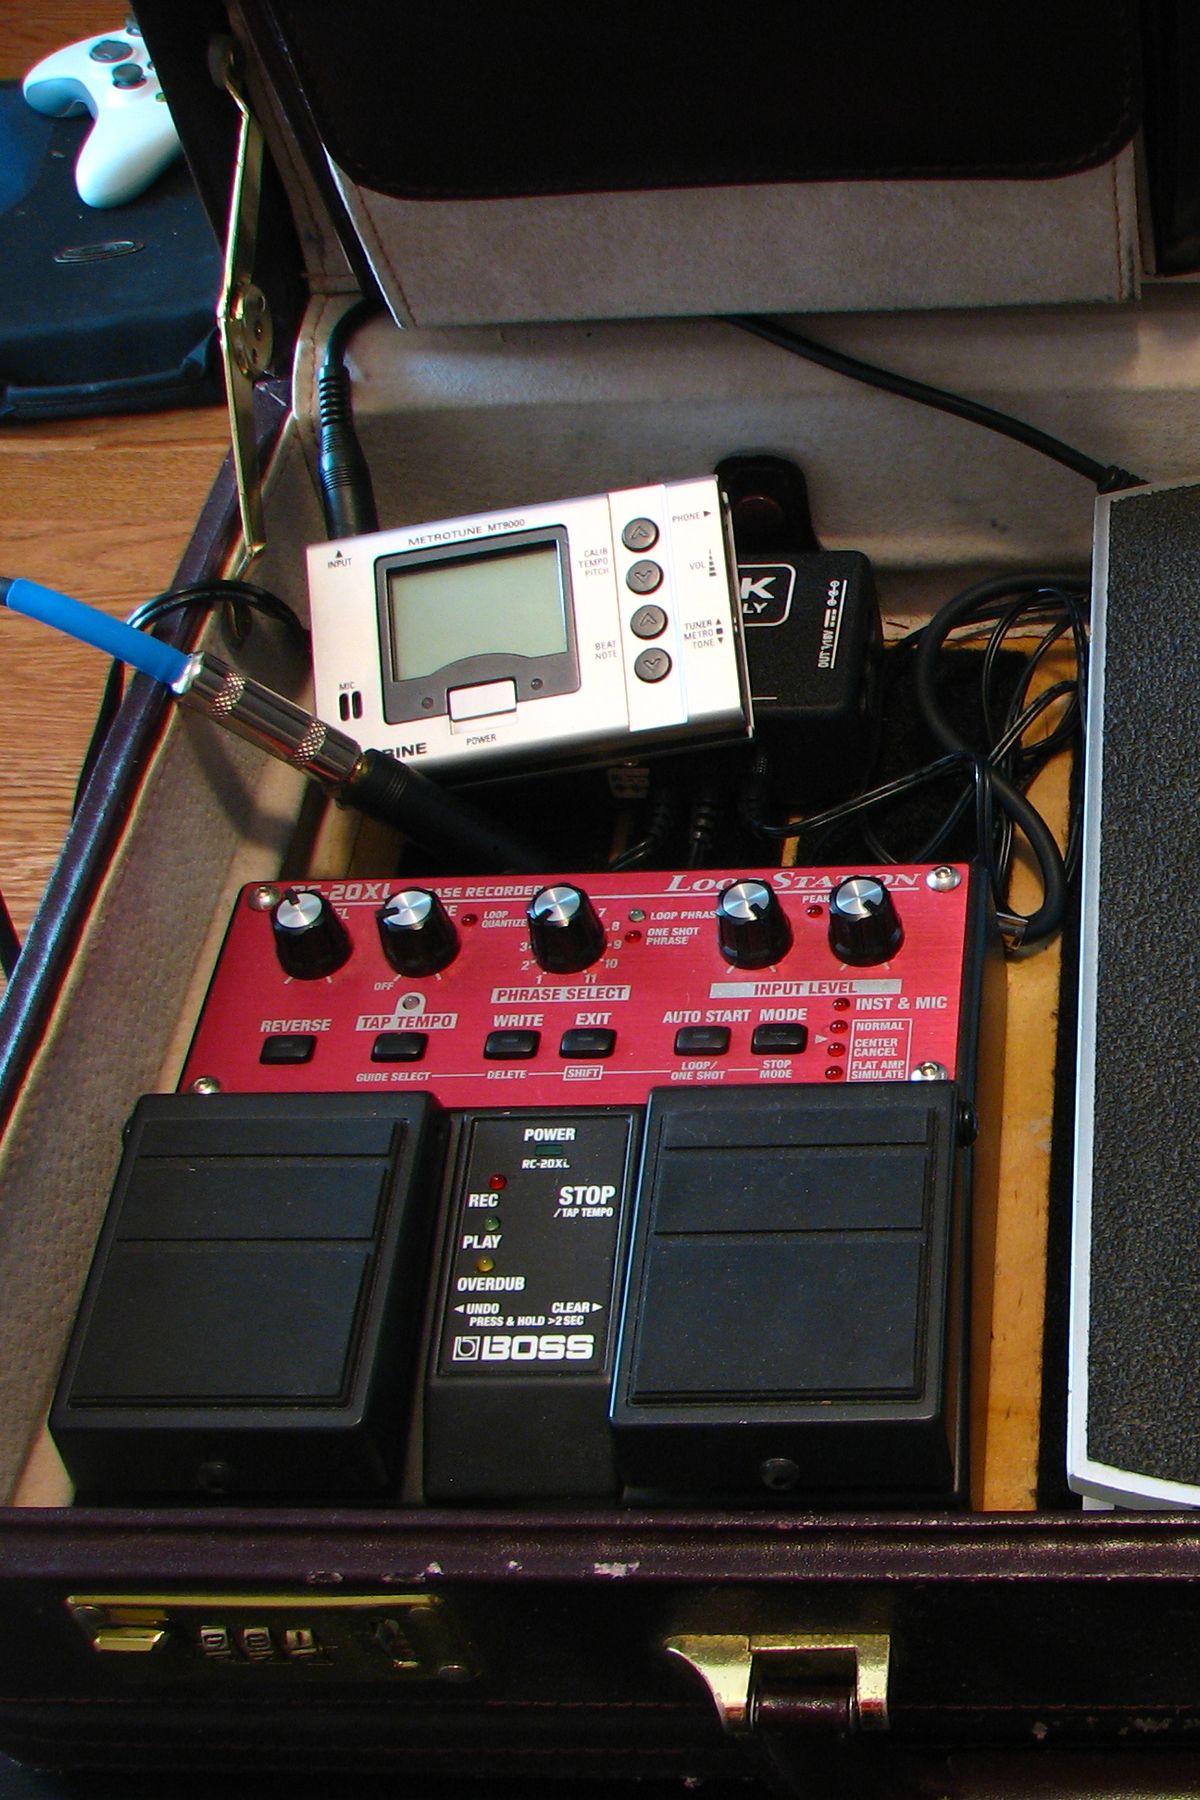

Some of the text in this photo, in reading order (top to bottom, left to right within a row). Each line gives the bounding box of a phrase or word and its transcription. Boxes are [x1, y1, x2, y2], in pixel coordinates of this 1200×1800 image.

[671, 512, 700, 522] PHONE
[408, 519, 526, 546] METROTUNE MT9000
[328, 558, 351, 568] INPUT
[578, 557, 609, 568] TEMPO
[689, 562, 705, 570] VOL
[684, 619, 712, 630] TUNER
[683, 628, 714, 640] METRO
[595, 640, 616, 650] BEAT
[692, 638, 715, 649] TONE
[595, 650, 617, 660] NOTE
[817, 650, 830, 668] OUT
[339, 681, 354, 690] MIC
[466, 734, 497, 746] POWER
[802, 894, 830, 904] PEAK
[484, 911, 509, 919] LOOP
[650, 910, 718, 921] LOOP PHRAS
[482, 918, 528, 929] QUANTIZE
[647, 926, 699, 937] ONE SHOT
[646, 936, 688, 946] PHRASE
[520, 942, 528, 952] 3
[521, 961, 530, 971] 2
[605, 959, 618, 969] 10
[536, 974, 543, 985] 1
[584, 974, 597, 984] 11
[374, 982, 394, 991] OFF
[754, 981, 857, 996] INPUT LEVEL
[497, 986, 625, 1001] PHRASE SELECT
[855, 997, 948, 1011] INST & MIC
[493, 1014, 544, 1027] WRITE
[575, 1012, 612, 1026] EXIT
[662, 1009, 752, 1023] AUTO START
[759, 1008, 808, 1022] MODE
[260, 1018, 332, 1032] REVERSE
[361, 1015, 451, 1029] TAP TEMPO
[856, 1022, 904, 1031] NORMAL
[855, 1038, 898, 1048] CENTER
[853, 1047, 898, 1057] CANCEL
[681, 1061, 718, 1071] LOOP/
[763, 1059, 792, 1069] STOP
[852, 1060, 905, 1070] FLAT AMP
[356, 1072, 432, 1082] GUIDE SELECT
[486, 1070, 528, 1079] DELETE
[566, 1068, 600, 1078] SHIFT
[670, 1070, 726, 1081] ONE SHOT
[759, 1069, 793, 1079] MODE
[851, 1069, 905, 1079] SIMULATE
[524, 1128, 576, 1142] POWER
[521, 1158, 570, 1169] RC-20XL
[468, 1193, 499, 1208] REC
[559, 1185, 616, 1206] STOP
[553, 1207, 614, 1218] /TAP TEMPO
[462, 1234, 502, 1249] PLAY
[457, 1276, 526, 1292] OVERDUB
[466, 1303, 500, 1315] UNDO
[551, 1302, 590, 1314] CLEAR
[469, 1316, 504, 1327] PRESS
[506, 1317, 514, 1327] &
[517, 1316, 545, 1327] HOLD
[481, 1334, 595, 1361] BOSS
